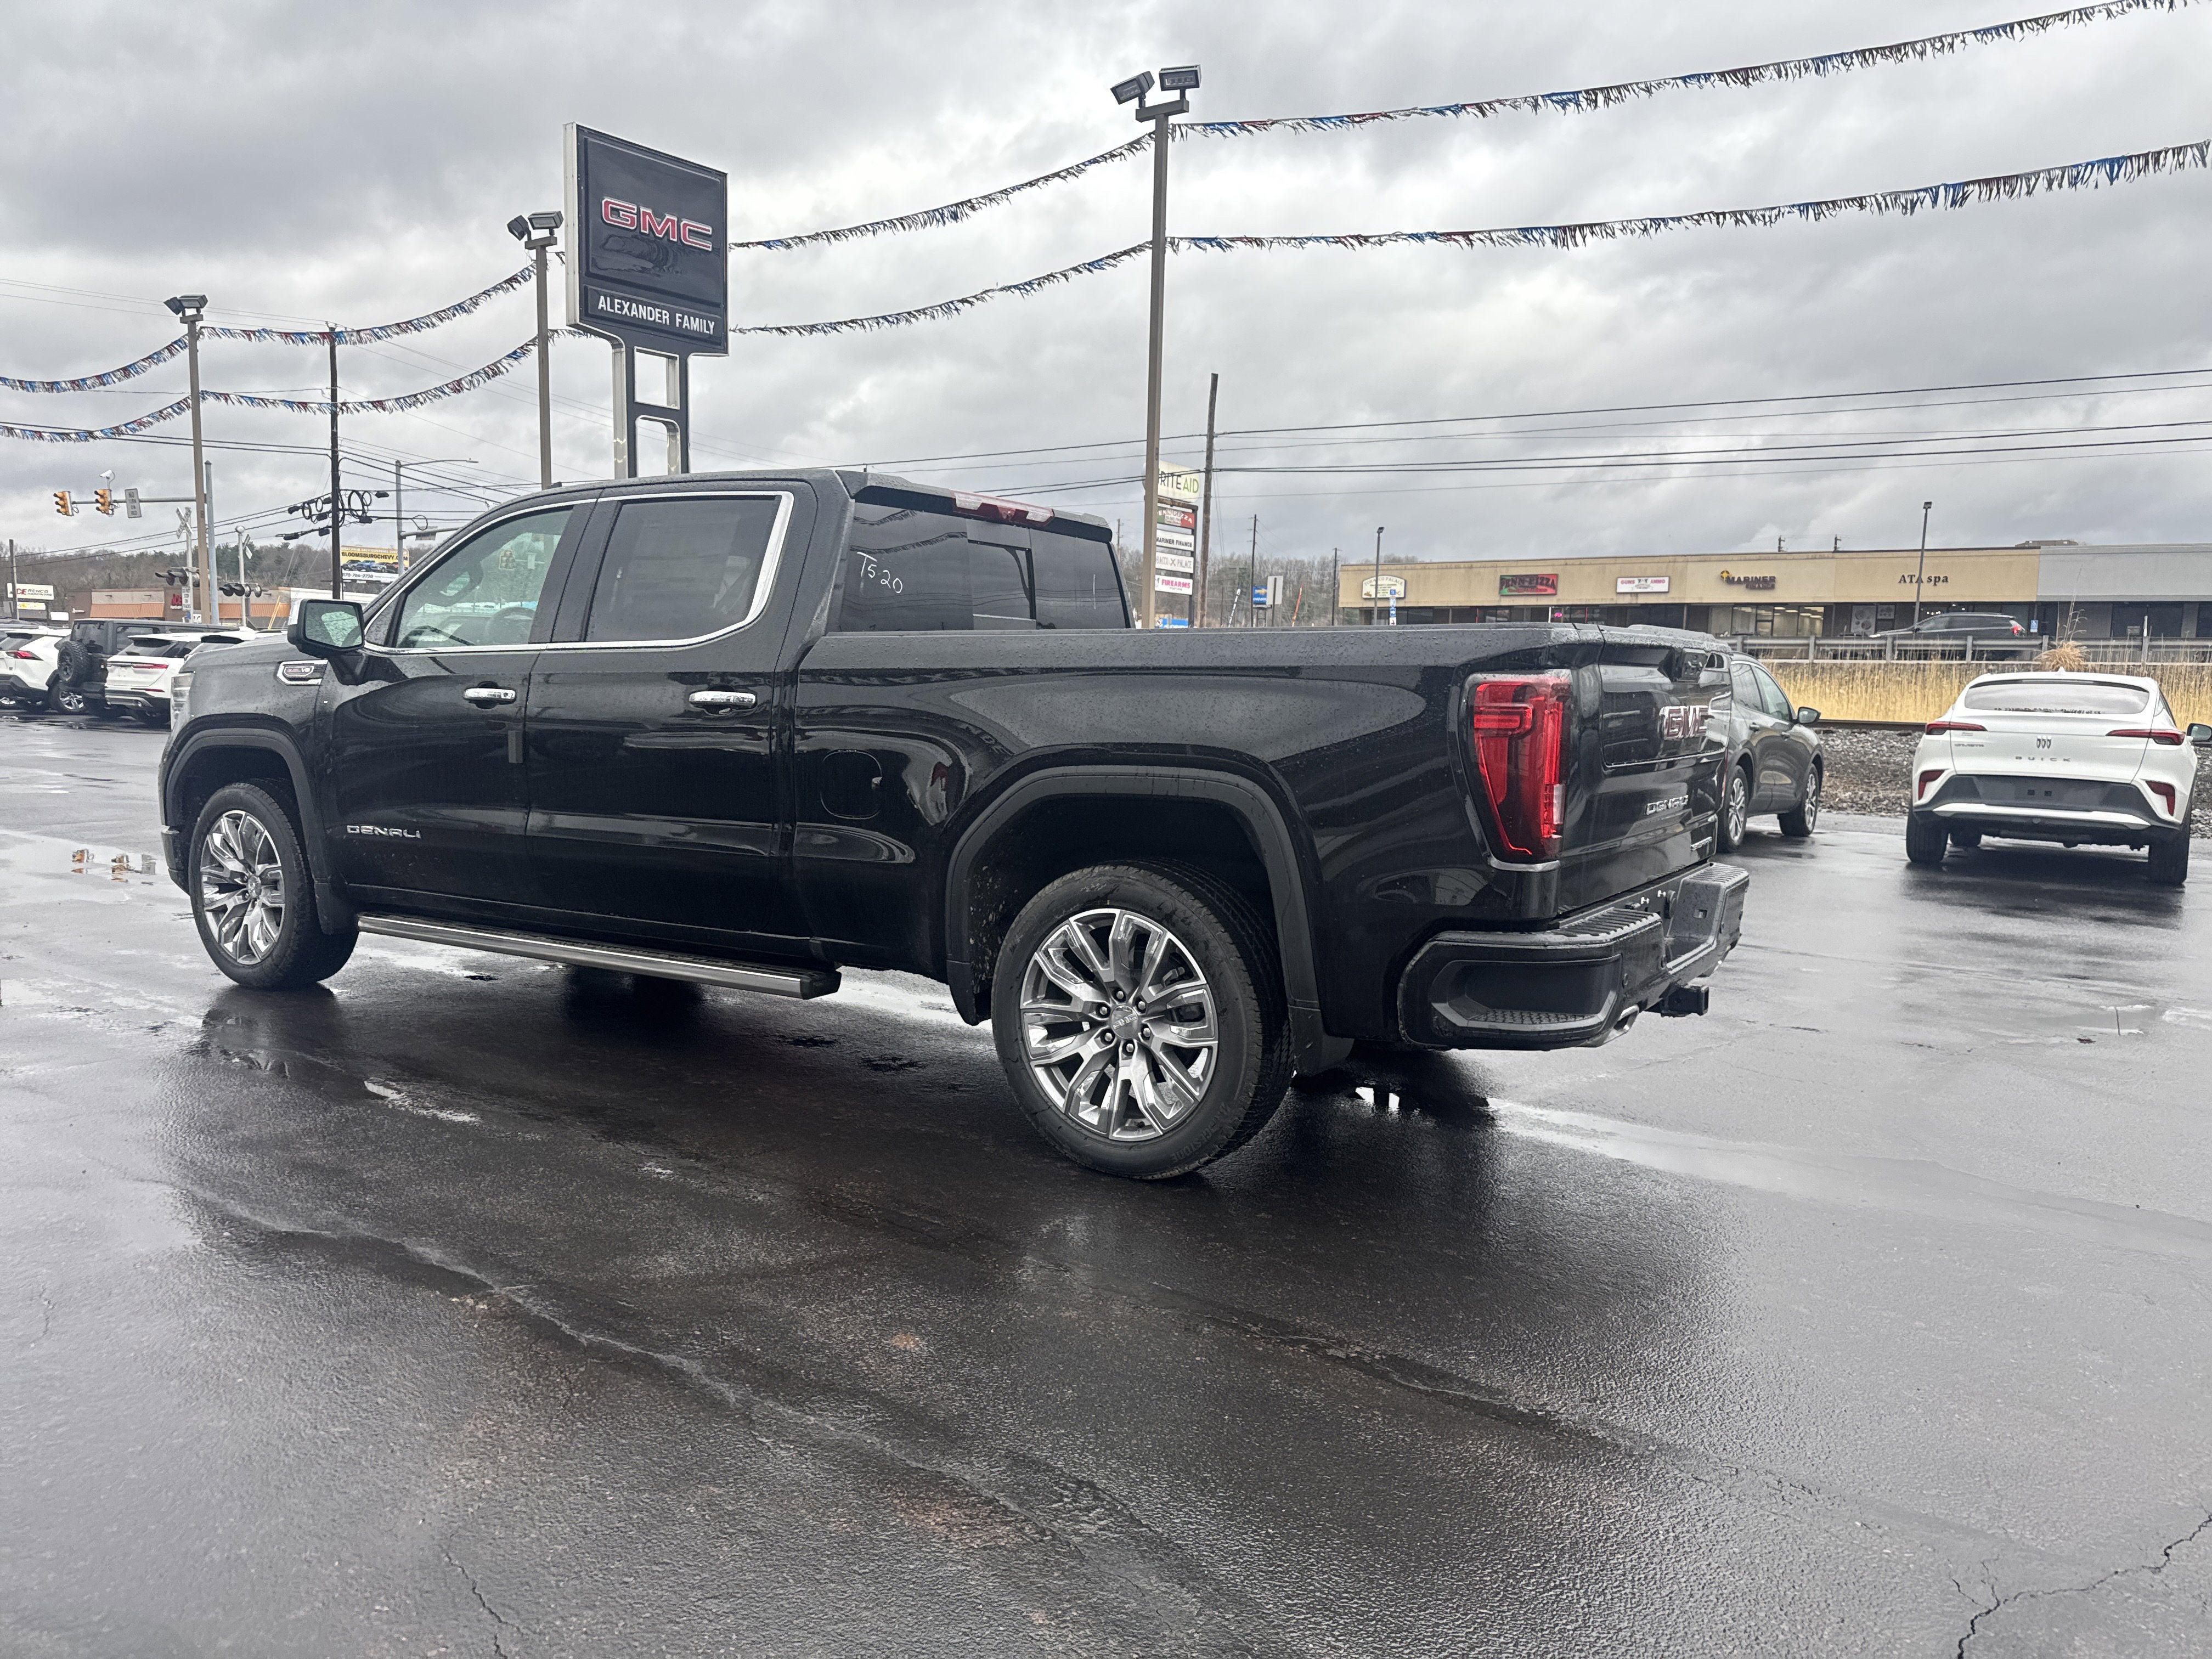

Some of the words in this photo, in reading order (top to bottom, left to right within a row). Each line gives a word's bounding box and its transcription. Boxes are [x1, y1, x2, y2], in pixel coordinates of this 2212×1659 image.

[601, 197, 712, 251] GMC
[597, 295, 670, 326] ALEXANDER
[675, 313, 715, 335] FAMILY
[1160, 471, 1182, 490] RITE
[1183, 477, 1199, 493] AID
[1156, 536, 1175, 545] MARINER
[1176, 539, 1192, 548] FINANCE
[341, 551, 408, 561] BLOOMSBURGCHEVY.CM
[1156, 556, 1169, 566] BACCO
[1177, 558, 1192, 569] PALACE
[1161, 579, 1190, 589] FIREARMS
[1364, 577, 1385, 586] TOBACO
[1726, 576, 1776, 584] MARINER
[1898, 574, 1924, 583] ATA
[1927, 575, 1949, 586] spa
[1661, 706, 1708, 740] GMC
[1646, 794, 1689, 815] DENALI
[346, 825, 421, 839] DENALI
[1113, 1013, 1137, 1030] GMC
